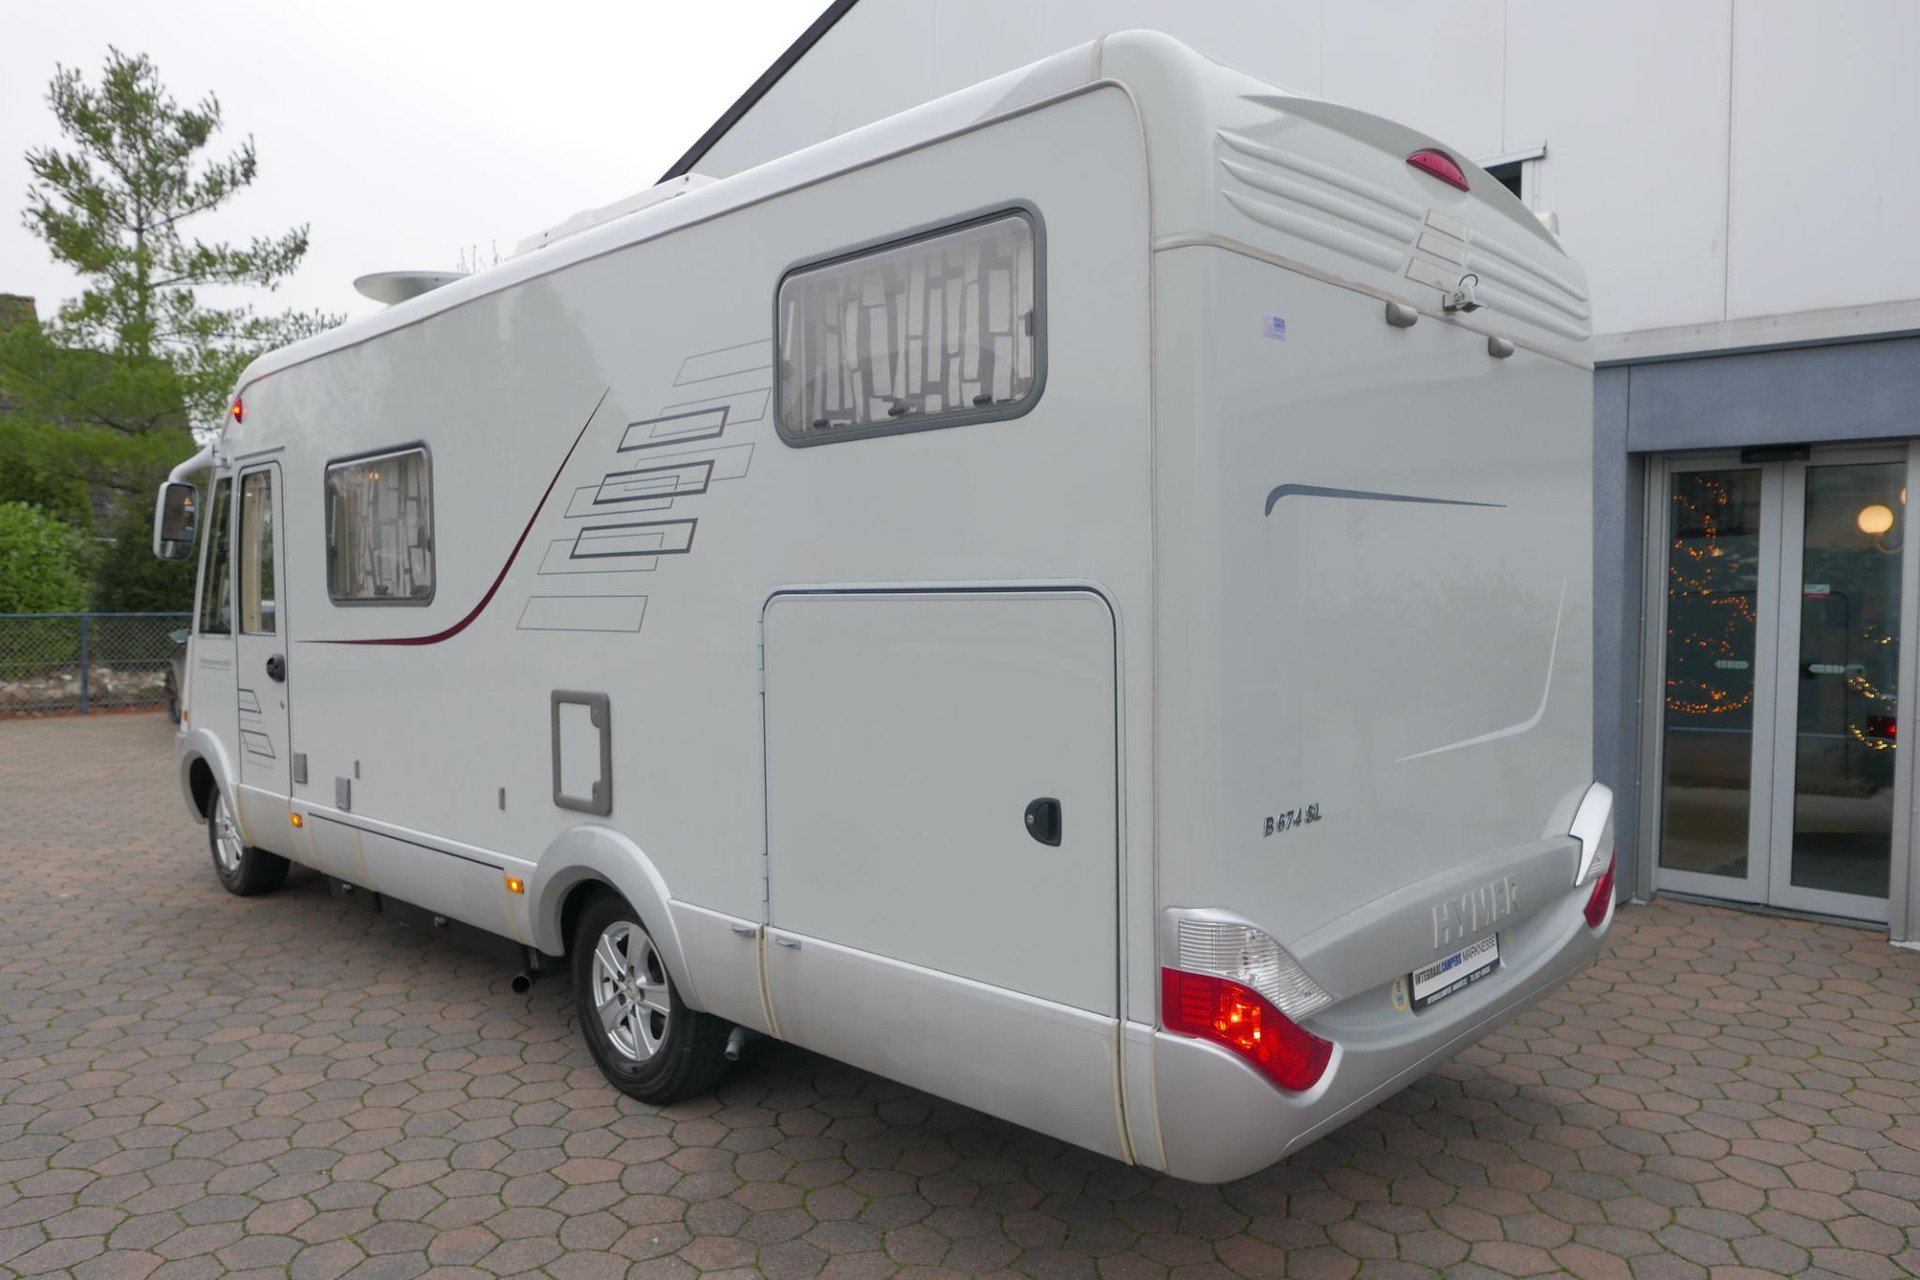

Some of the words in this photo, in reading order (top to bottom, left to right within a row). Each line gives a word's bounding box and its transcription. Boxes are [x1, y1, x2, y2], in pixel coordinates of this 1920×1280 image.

[1264, 816, 1275, 838] B
[1277, 808, 1302, 832] 674
[1305, 802, 1322, 824] SL
[1432, 876, 1521, 949] HYMER
